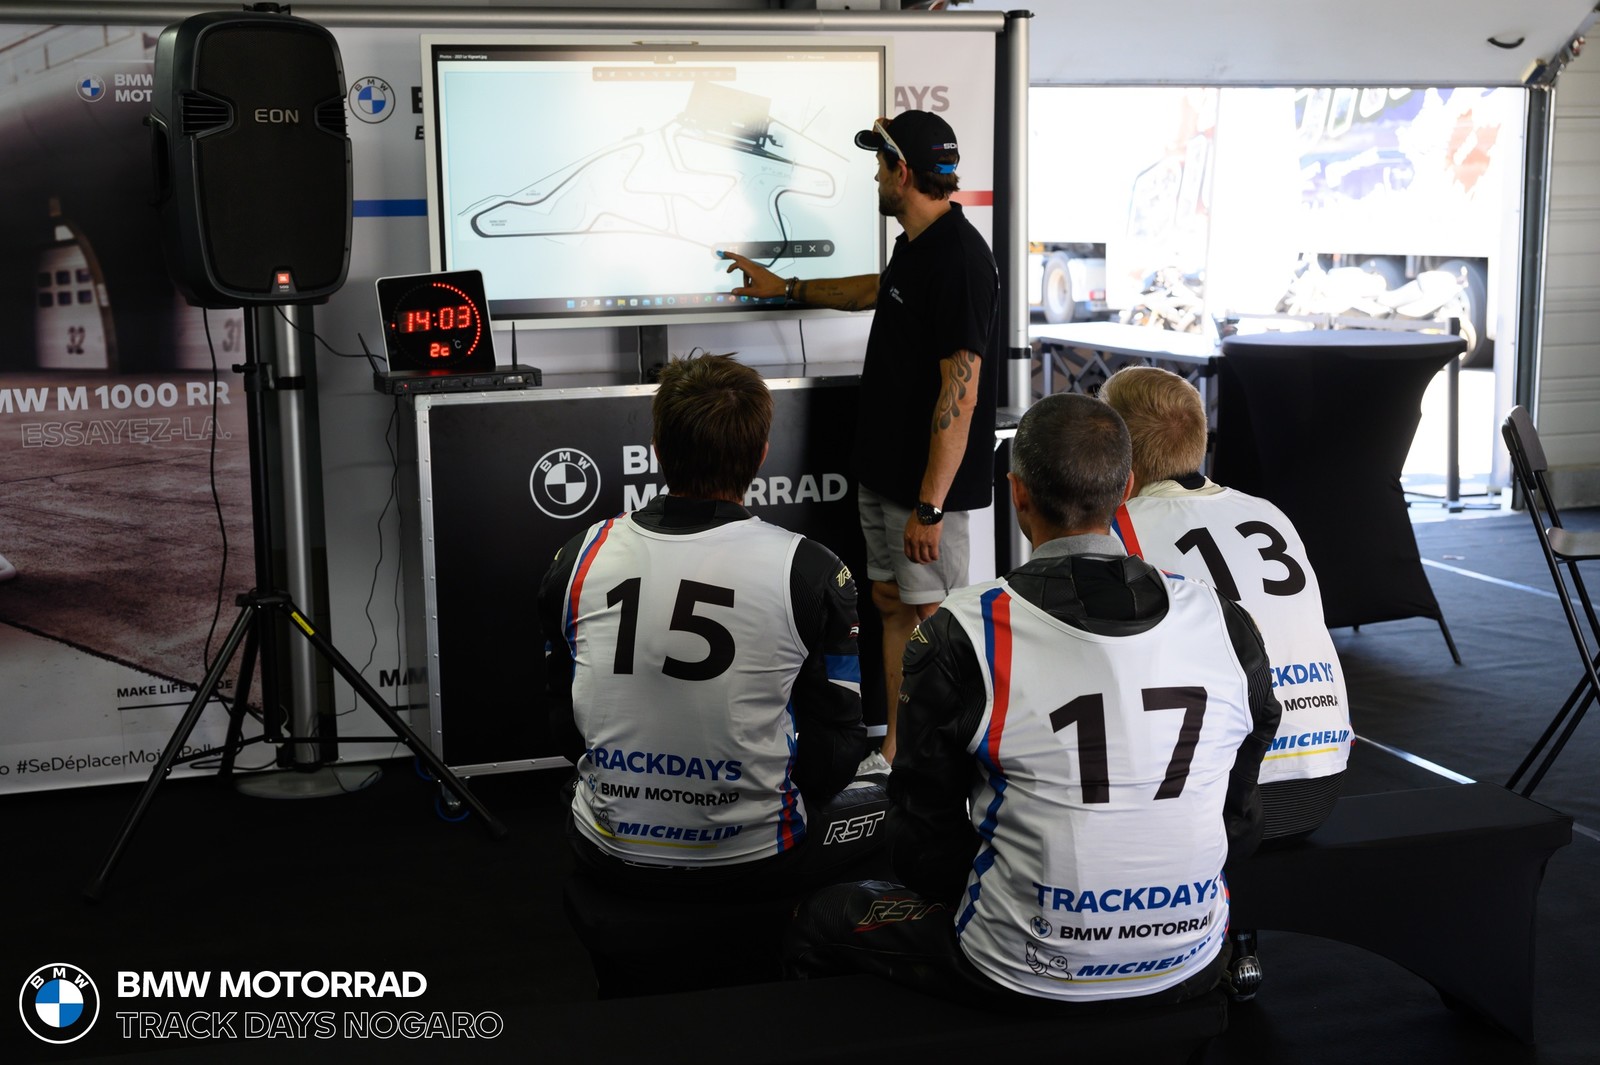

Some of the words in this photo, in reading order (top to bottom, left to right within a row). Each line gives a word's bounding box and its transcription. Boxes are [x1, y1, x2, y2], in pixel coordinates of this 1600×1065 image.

[354, 79, 389, 92] BMW
[254, 108, 299, 123] EON
[408, 305, 471, 332] 14:03
[57, 386, 89, 411] M
[95, 383, 178, 410] 1000
[186, 381, 231, 406] RR
[21, 416, 232, 448] ESSAYEZ-LA.
[539, 452, 591, 473] BMW
[1174, 520, 1306, 602] 13
[606, 577, 736, 681] 15
[117, 685, 156, 698] MAKE
[160, 683, 186, 695] LIFE
[1049, 686, 1208, 804] 17
[601, 782, 640, 799] BMW
[645, 787, 740, 807] MOTORRAD
[617, 822, 743, 842] MICHELIN
[823, 810, 886, 846] RST
[1032, 874, 1219, 913] TRACKDAYS
[1060, 926, 1113, 941] BMW
[1118, 911, 1212, 940] MOTORRA
